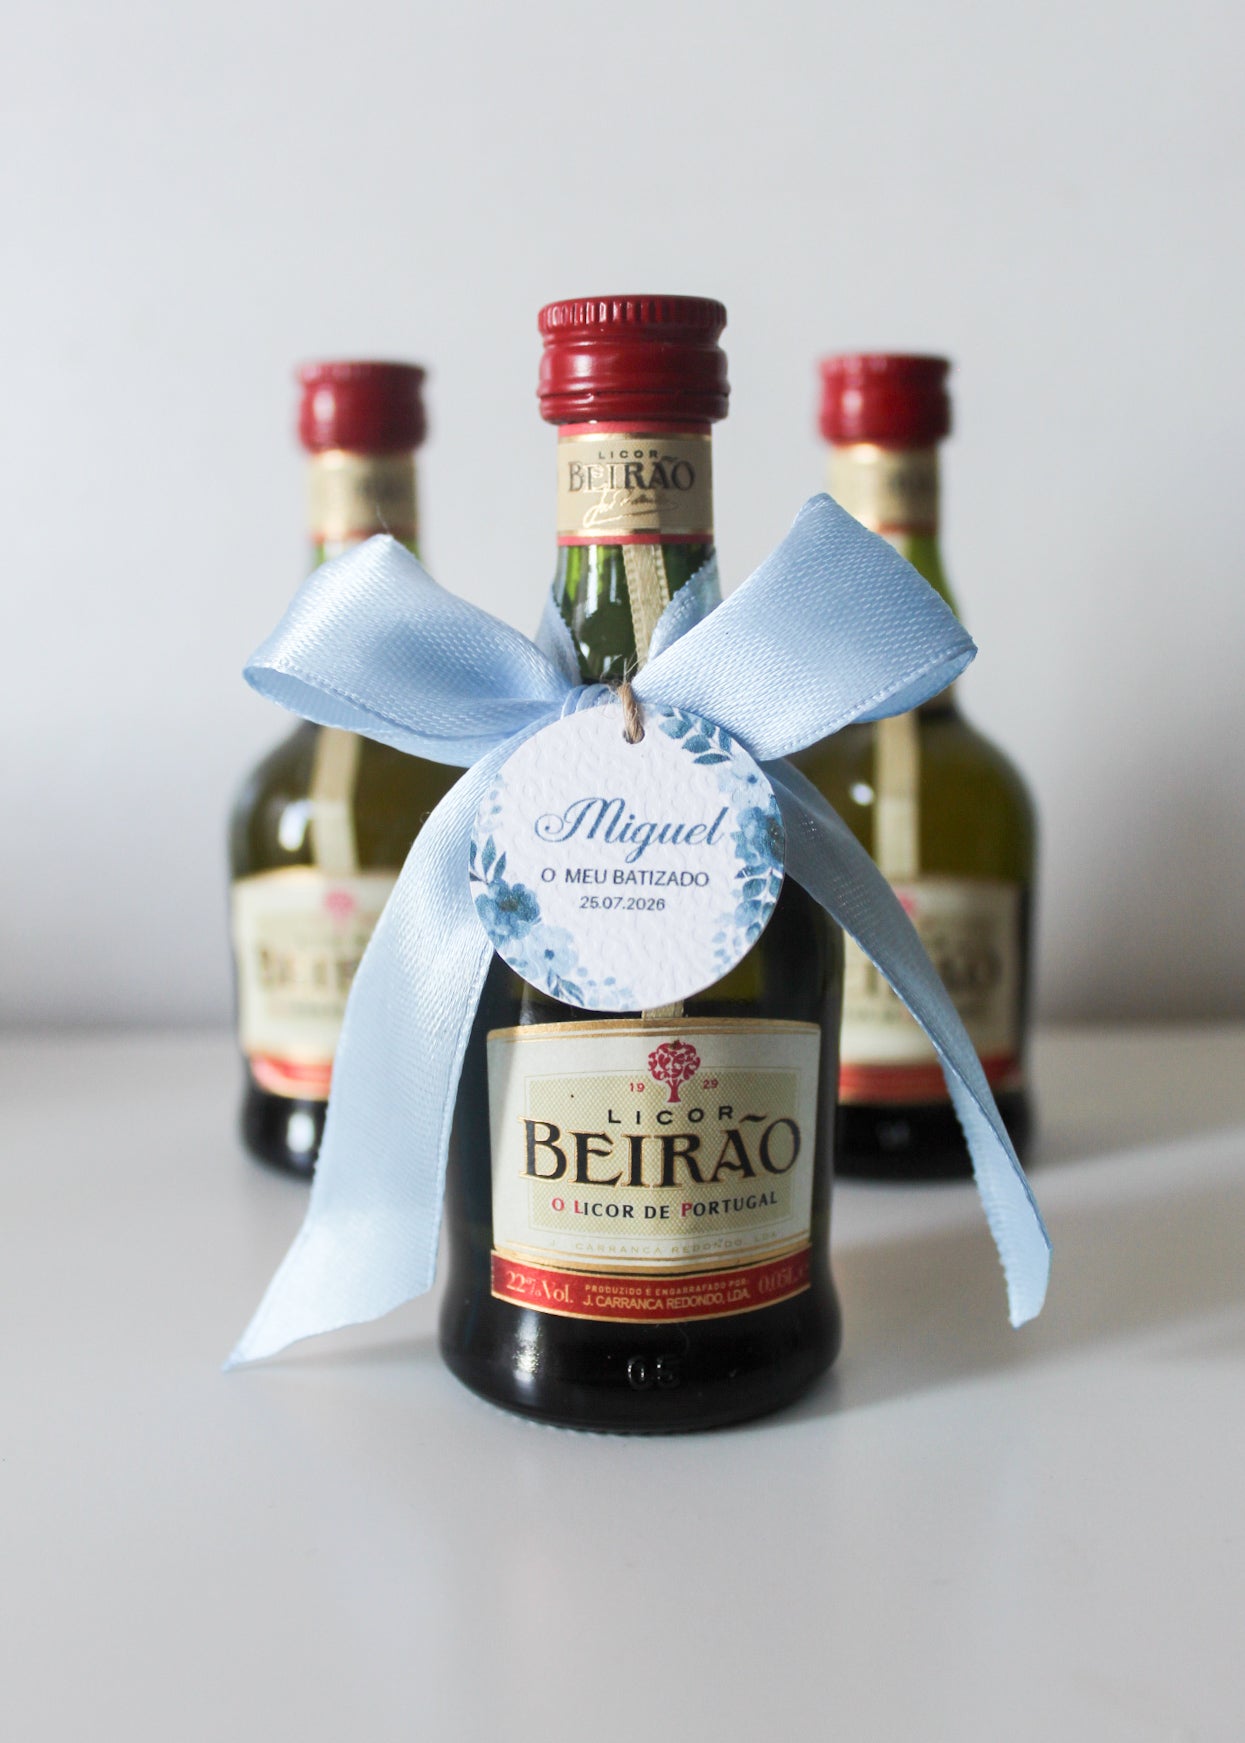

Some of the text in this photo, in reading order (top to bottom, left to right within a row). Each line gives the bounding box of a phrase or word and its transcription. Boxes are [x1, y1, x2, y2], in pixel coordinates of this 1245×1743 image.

[599, 450, 660, 460] LICOR
[568, 456, 696, 491] BEIRÃO
[534, 797, 729, 863] Miguel
[541, 868, 710, 887] O MEU BATIZADO
[579, 896, 665, 911] 25.07.2026
[630, 1082, 645, 1093] 19
[703, 1079, 718, 1090] 29
[608, 1105, 734, 1125] LICOR
[518, 1114, 801, 1190] BEIRÃO
[552, 1191, 778, 1219] O LICOR DE PORTUGAL
[575, 1242, 663, 1255] CARRANCA
[585, 1284, 641, 1295] PRODUZIDO
[583, 1296, 594, 1306] J.
[596, 1295, 664, 1310] CARRANCA
